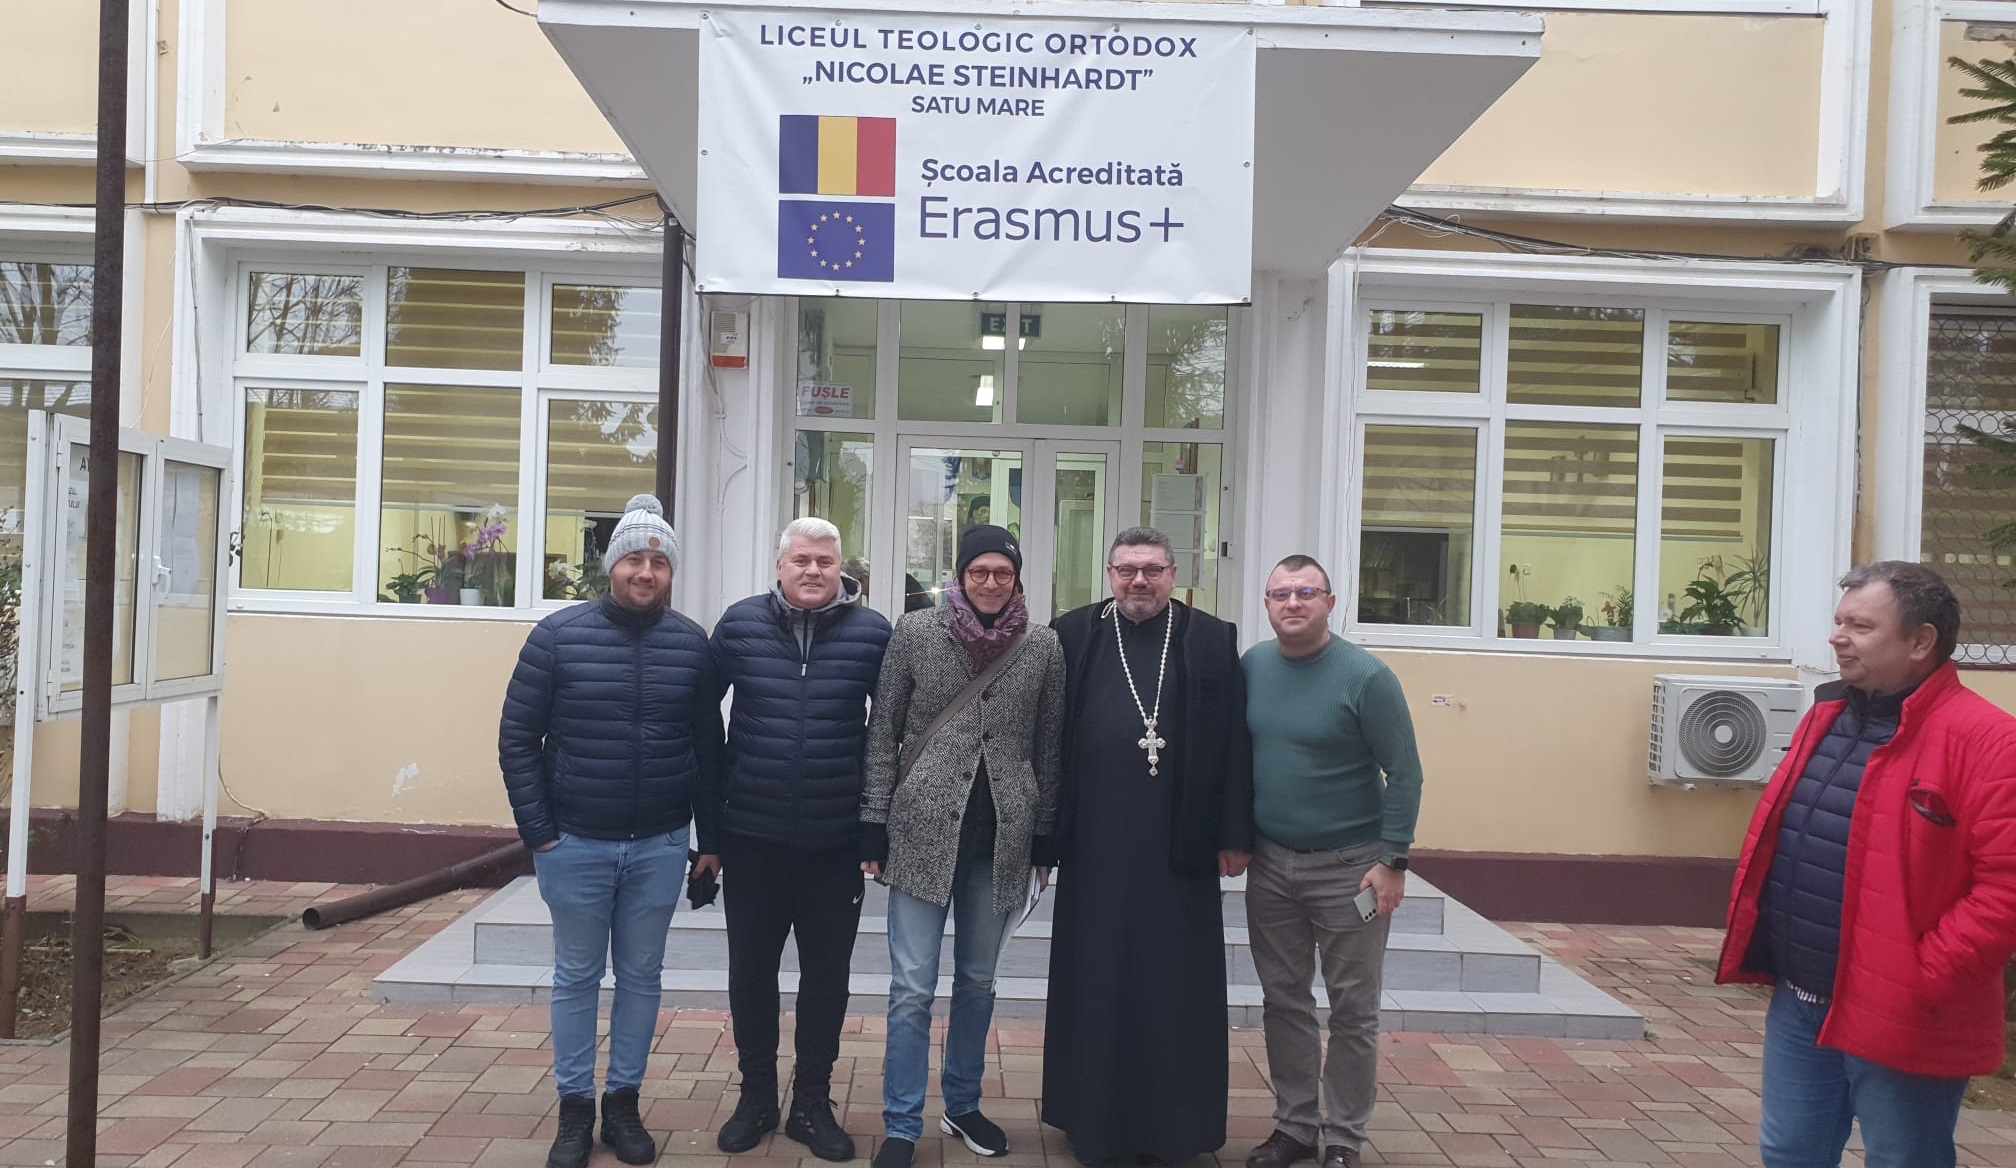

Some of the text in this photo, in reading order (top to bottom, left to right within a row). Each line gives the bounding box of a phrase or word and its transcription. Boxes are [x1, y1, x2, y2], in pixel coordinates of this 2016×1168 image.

[760, 25, 1197, 58] LICEUL TEOLOGIC ORTODOX
[911, 96, 1045, 117] SATU MARE
[921, 158, 1183, 187] Școala Acreditată
[920, 196, 1185, 243] Erasmus+
